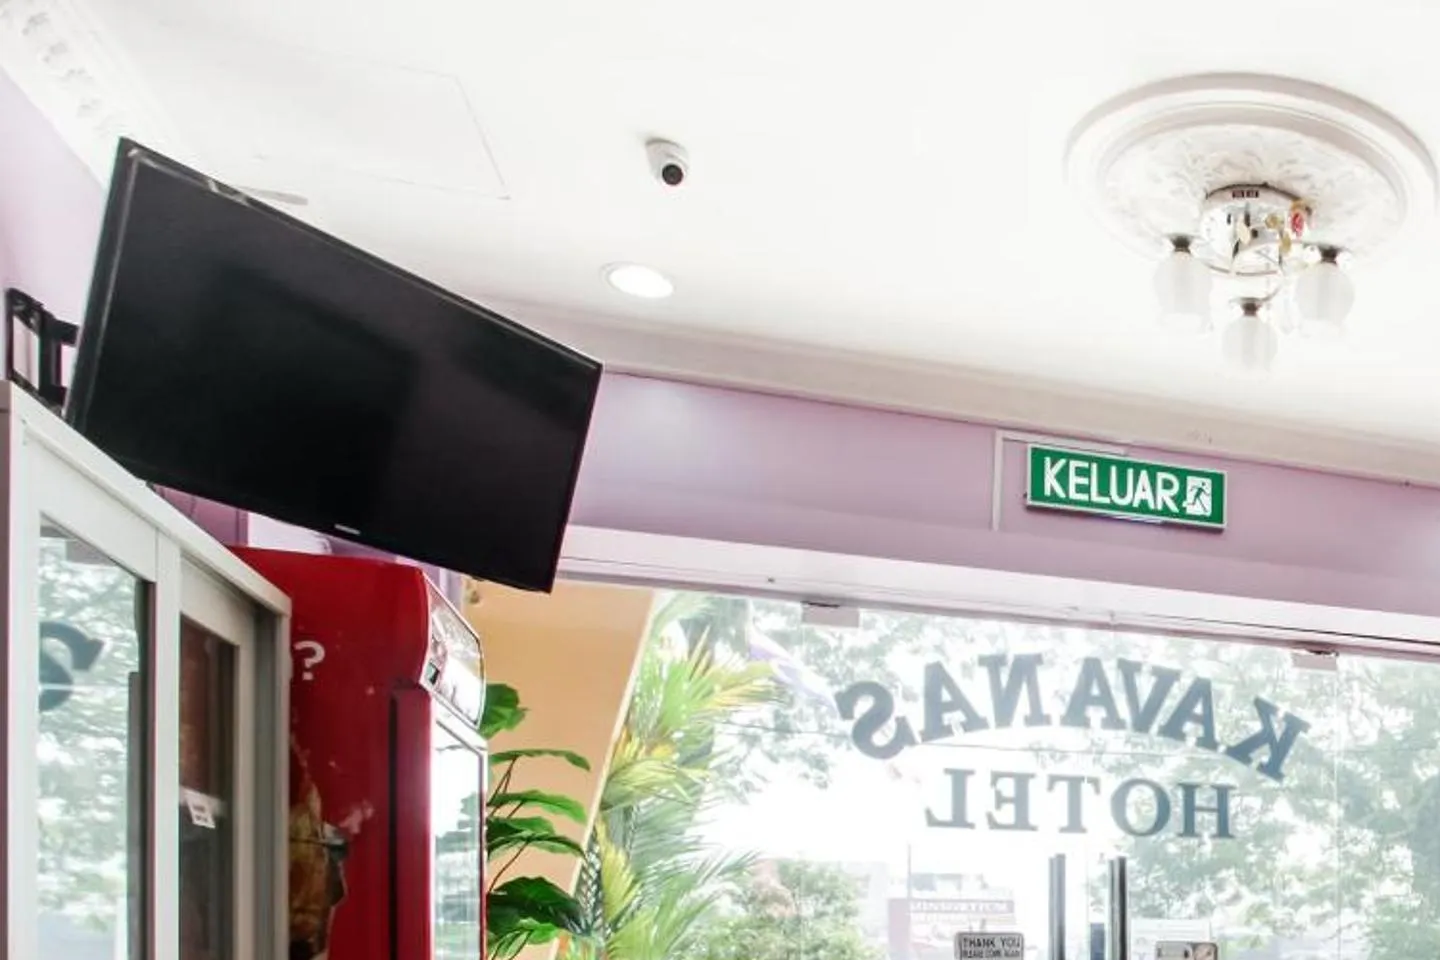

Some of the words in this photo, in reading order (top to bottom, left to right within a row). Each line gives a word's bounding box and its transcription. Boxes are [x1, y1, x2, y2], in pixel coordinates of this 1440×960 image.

[1043, 456, 1180, 513] KELUAR
[963, 937, 996, 949] THANK
[1000, 936, 1020, 948] YOU
